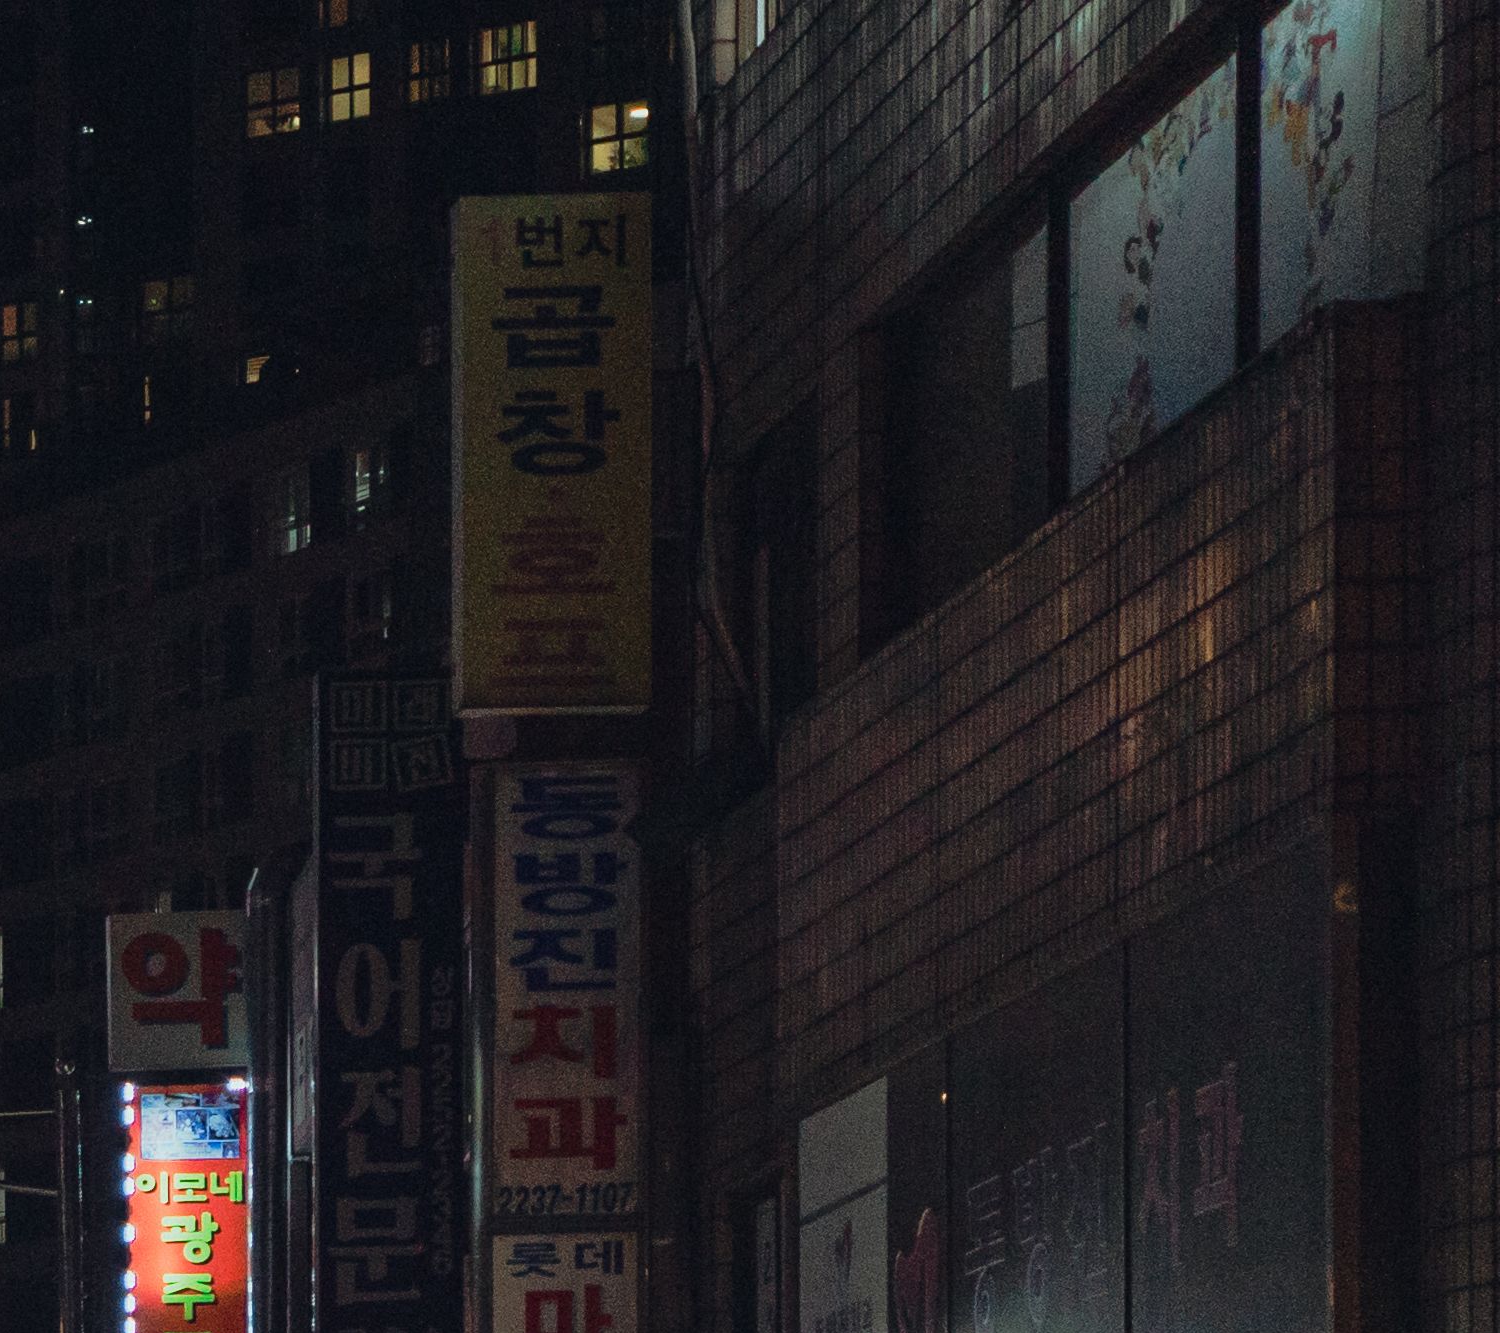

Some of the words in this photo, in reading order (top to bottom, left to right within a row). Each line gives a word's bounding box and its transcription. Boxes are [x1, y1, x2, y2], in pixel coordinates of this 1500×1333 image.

[490, 285, 620, 477] 곱창
[492, 518, 618, 690] 호프
[120, 927, 244, 1049] 약
[508, 774, 628, 1171] 동방진치과
[328, 814, 423, 1308] 국어전문
[136, 1169, 244, 1204] 이모네
[498, 1183, 631, 1215] 2237-1107
[506, 1239, 625, 1278] 롯데
